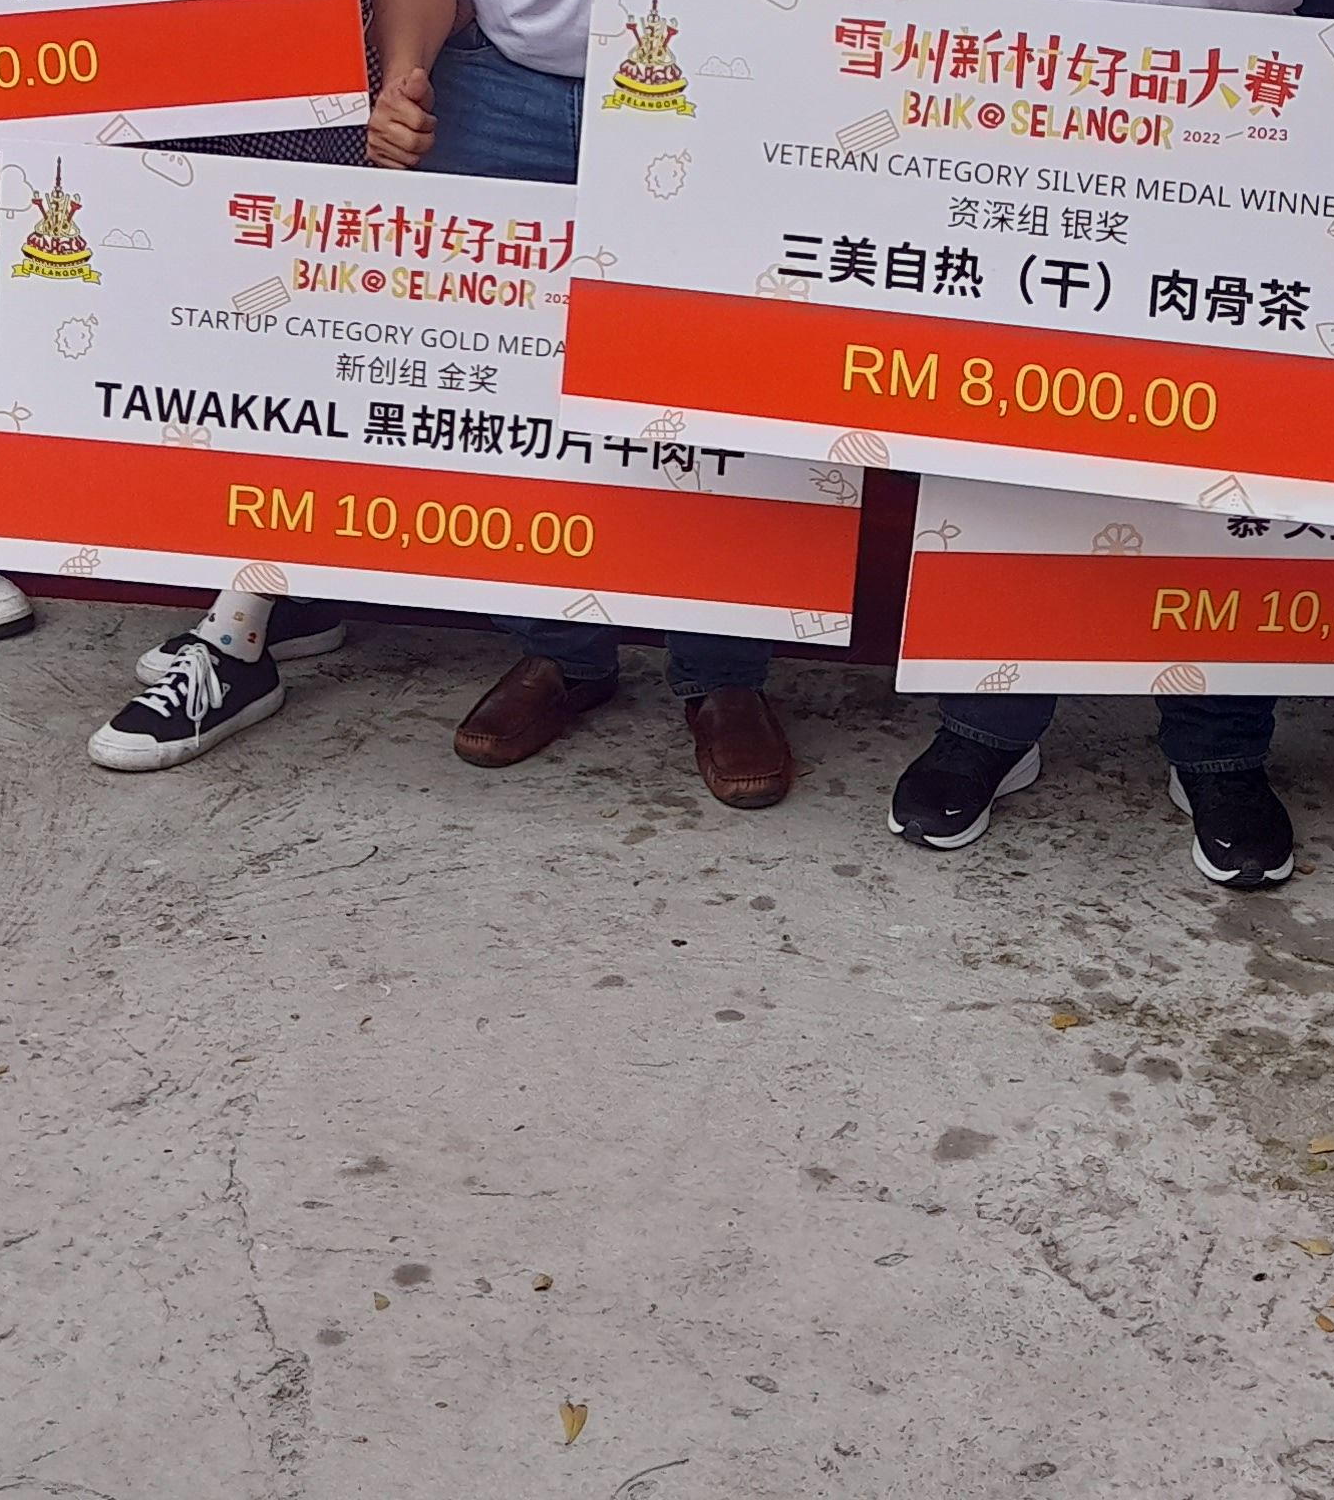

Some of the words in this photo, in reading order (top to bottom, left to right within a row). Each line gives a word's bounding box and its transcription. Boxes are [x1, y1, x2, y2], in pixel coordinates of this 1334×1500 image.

[1182, 129, 1221, 145] 2022
[1246, 126, 1289, 142] 2023
[763, 142, 877, 175] VETERAN
[887, 153, 1029, 190] CATEGORY
[1035, 168, 1126, 200] SILVER
[1135, 178, 1232, 208] MEDAL
[948, 196, 1050, 236] 资深组
[1060, 205, 1130, 245] 银奖
[544, 293, 570, 305] 202
[170, 305, 278, 336] STARTUP
[285, 315, 413, 348] CATEGORY
[421, 326, 490, 352] GOLD
[497, 331, 566, 358] MEDA
[335, 353, 429, 389] 新创组
[438, 361, 499, 395] 金奖
[841, 343, 939, 401] RM
[959, 354, 1218, 432] 8,000.00
[95, 380, 349, 441] TAWAKKAL
[226, 483, 314, 533] RM
[334, 494, 595, 559] 10,000.00
[1150, 587, 1239, 633] RM
